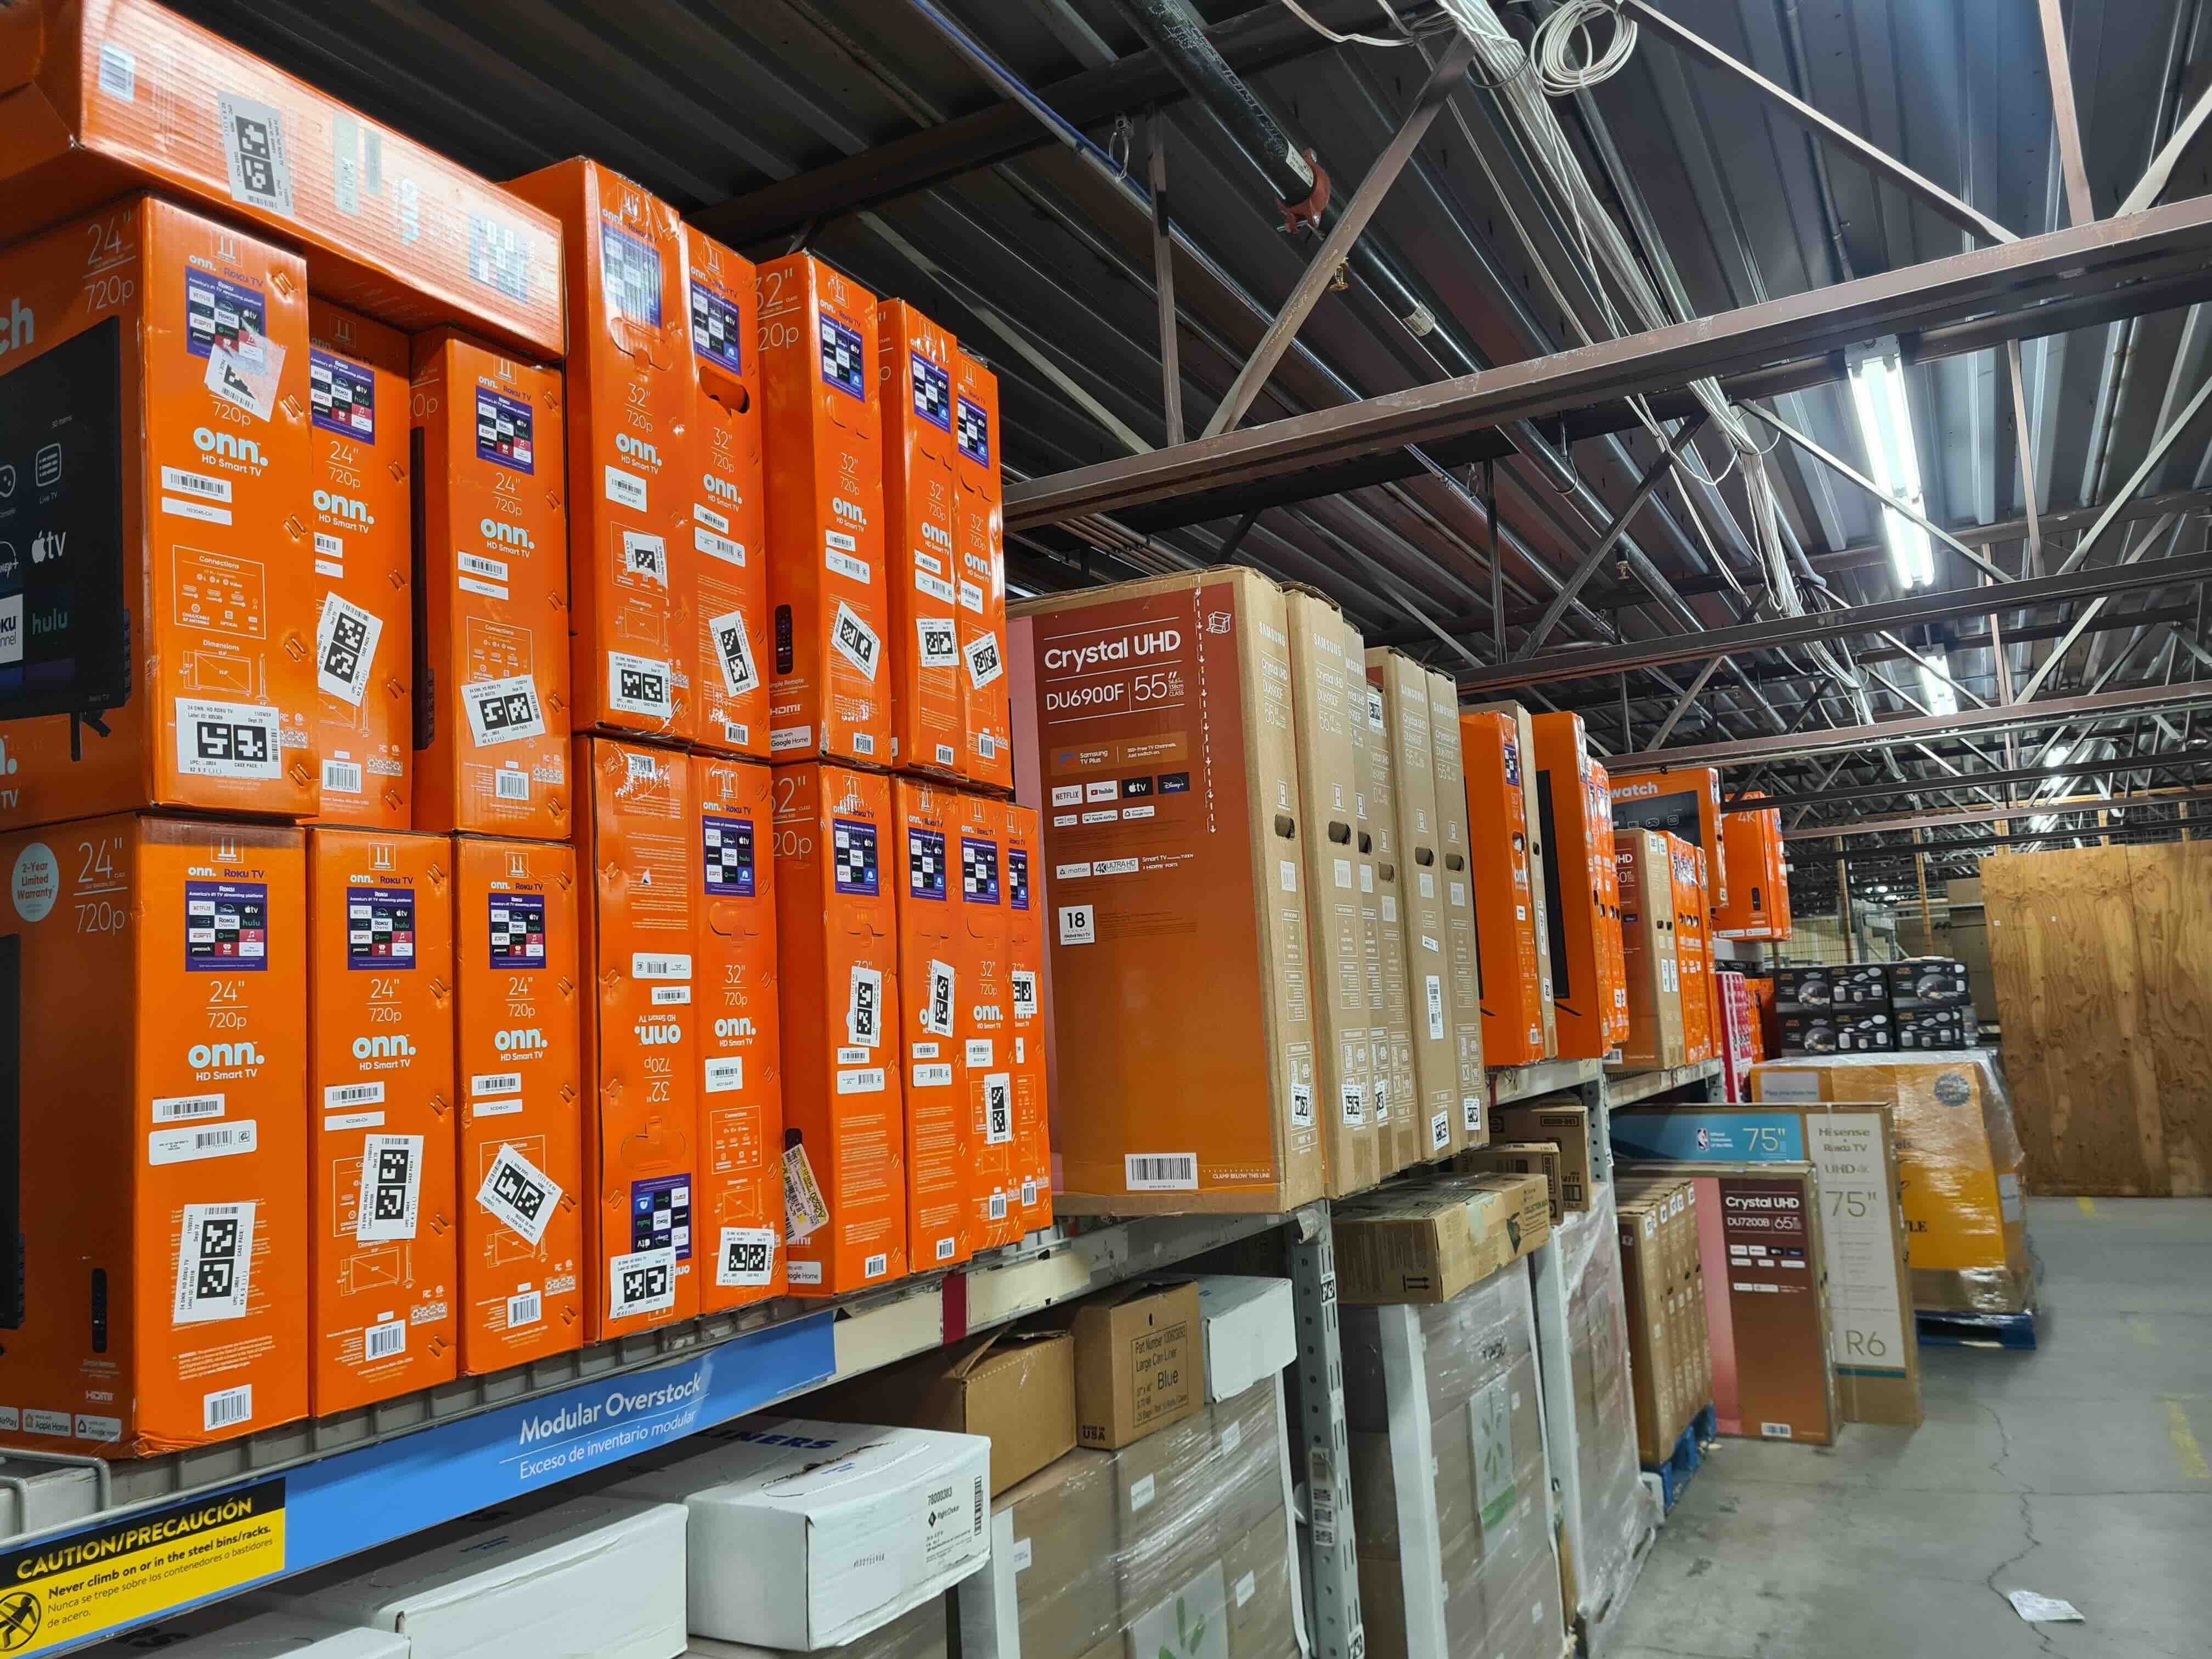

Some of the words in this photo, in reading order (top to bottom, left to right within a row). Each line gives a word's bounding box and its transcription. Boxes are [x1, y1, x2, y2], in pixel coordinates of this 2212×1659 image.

[628, 382, 650, 408] 32"
[213, 400, 251, 427] 720p
[627, 409, 653, 433] 720p
[193, 427, 268, 466] onn.
[713, 427, 732, 450] 32"
[329, 439, 359, 464] 24"
[616, 432, 663, 466] onn.
[202, 454, 216, 464] HD
[219, 459, 247, 473] Smart
[250, 465, 262, 477] TV
[621, 456, 630, 464] HD
[632, 459, 650, 471] Smart
[651, 466, 658, 475] TV
[712, 452, 735, 473] 720p
[841, 452, 859, 470] 32"
[329, 466, 361, 489] 720p
[495, 472, 521, 493] 24"
[703, 473, 742, 504] onn.
[929, 480, 944, 500] 32"
[40, 495, 49, 505] Live
[313, 489, 375, 525] onn.
[495, 496, 522, 517] 720p
[832, 496, 867, 524] onn.
[319, 514, 331, 524] HD
[333, 517, 355, 529] Smart
[357, 523, 369, 533] TV
[481, 518, 535, 549] onn.
[487, 540, 497, 550] HD
[499, 543, 519, 555] Smart
[520, 548, 531, 558] TV
[199, 555, 240, 569] Connections
[32, 608, 68, 635] hulu
[1259, 622, 1285, 647] SAMSUNG
[202, 639, 240, 652] Dimensions
[1045, 637, 1128, 673] Crystal
[1134, 630, 1181, 656] UHD
[1313, 633, 1343, 657] SAMSUNG
[1046, 683, 1124, 710] DU6900F
[1135, 671, 1177, 701] 55"
[772, 738, 791, 747] Google
[792, 737, 808, 745] Home
[1080, 750, 1108, 759] Samsung
[1056, 791, 1079, 801] NETFLIX
[1136, 783, 1146, 792] tv
[1737, 811, 1756, 823] 4K
[21, 861, 48, 874] 2-Year
[78, 837, 123, 884] 24"
[1095, 862, 1107, 873] 4K
[1107, 861, 1125, 869] ULTRA
[21, 873, 49, 887] Limited
[188, 866, 217, 878] onn.
[224, 868, 249, 878] Roku
[251, 870, 264, 878] TV
[380, 876, 401, 885] Roku
[515, 882, 533, 891] Roku
[74, 902, 125, 935] 720p
[1067, 912, 1085, 928] 18
[725, 964, 746, 983] 32"
[210, 980, 245, 1002] 24"
[370, 979, 400, 999] 24"
[509, 977, 533, 995] 24"
[724, 992, 747, 1007] 720p
[208, 1012, 247, 1030] 720p
[369, 1008, 402, 1024] 720p
[509, 1004, 535, 1019] 720p
[973, 1005, 1003, 1021] onn.
[714, 1018, 756, 1037] onn.
[352, 1035, 416, 1059] onn.
[494, 1028, 548, 1051] onn.
[188, 1041, 265, 1069] onn.
[359, 1062, 371, 1070] HD
[373, 1060, 399, 1070] Smart
[399, 1059, 410, 1068] TV
[500, 1053, 511, 1062] HD
[512, 1053, 533, 1061] Smart
[196, 1071, 211, 1081] HD
[213, 1070, 243, 1081] Smart
[245, 1069, 258, 1079] TV
[1742, 1128, 1786, 1152] 75"
[1819, 1128, 1870, 1137] Hisense
[1825, 1164, 1855, 1174] UHD
[1725, 1197, 1773, 1210] Crystal
[1773, 1198, 1799, 1209] UHD
[1825, 1190, 1877, 1217] 75"
[1728, 1216, 1770, 1227] DU7200B
[1845, 1329, 1886, 1357] R6
[1136, 1358, 1152, 1372] Large
[1158, 1369, 1179, 1390] Blue
[519, 1402, 602, 1445] Modular
[605, 1373, 702, 1418] Overstock
[520, 1453, 566, 1480] Exceso
[568, 1444, 584, 1463] de
[587, 1424, 648, 1458] inventario
[651, 1409, 697, 1437] modular
[1083, 1430, 1105, 1441] USA
[16, 1497, 253, 1581] CAUTION/PRECAUCIÓN
[48, 1581, 84, 1600] Never
[87, 1570, 120, 1588] climb
[122, 1565, 137, 1576] on
[140, 1560, 153, 1571] or
[154, 1556, 164, 1568] in
[167, 1549, 185, 1565] the
[188, 1539, 214, 1558] steel
[216, 1525, 272, 1548] bins/racks.
[48, 1596, 80, 1615] Nunca
[82, 1594, 92, 1603] se
[94, 1586, 120, 1604] trepe
[122, 1575, 147, 1592] sobre
[149, 1572, 162, 1583] los
[164, 1554, 223, 1578] contenedores
[232, 1538, 273, 1559] bastidores
[47, 1616, 59, 1628] de
[61, 1610, 92, 1625] acero.
